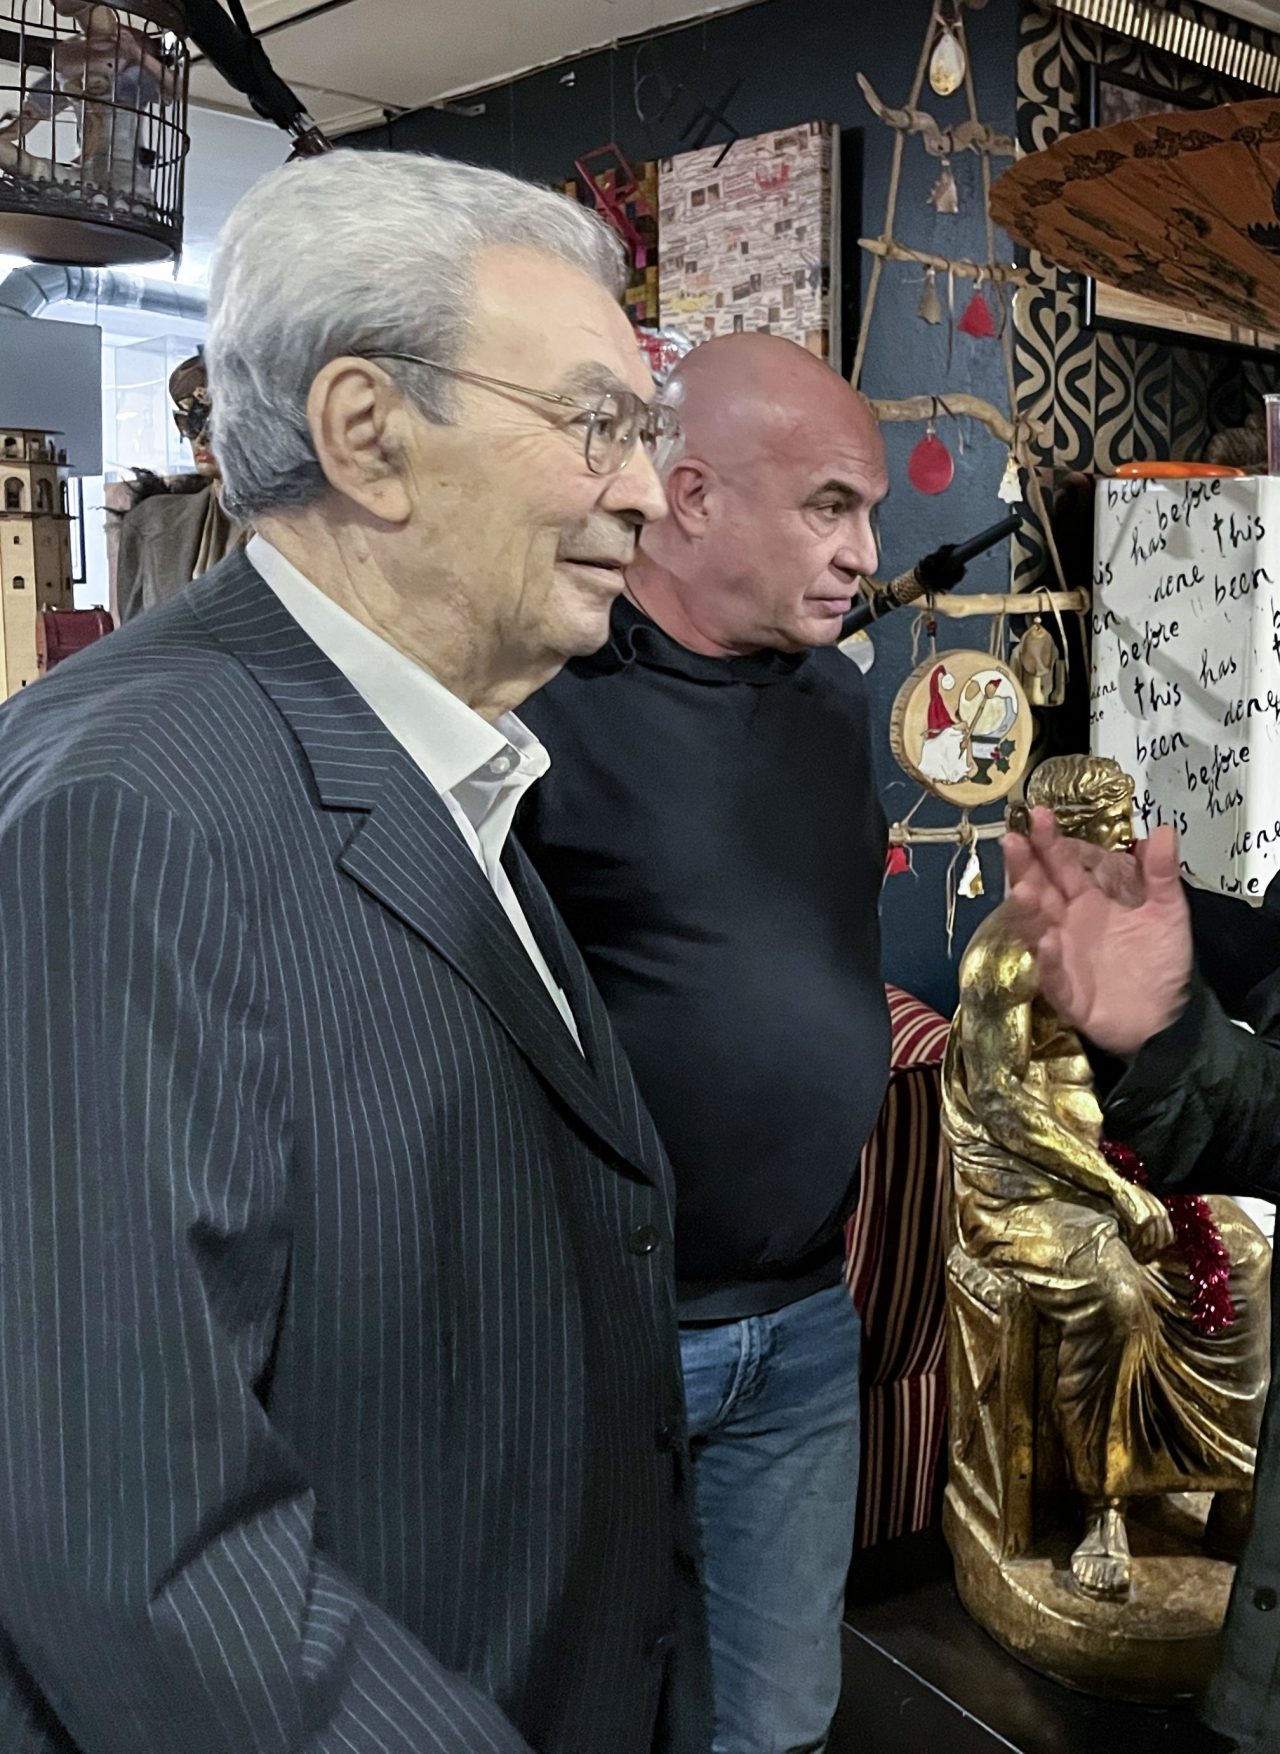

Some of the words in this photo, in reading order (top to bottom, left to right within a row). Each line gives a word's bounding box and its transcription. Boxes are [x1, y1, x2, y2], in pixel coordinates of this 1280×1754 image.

[1155, 479, 1221, 531] before
[1130, 526, 1167, 566] has
[1213, 512, 1265, 558] this
[1214, 568, 1275, 605] been
[1117, 620, 1179, 668] before
[1199, 648, 1237, 689] has
[1134, 676, 1181, 720] this
[1136, 732, 1190, 765] been
[1185, 744, 1251, 792] before
[1206, 778, 1244, 819] has
